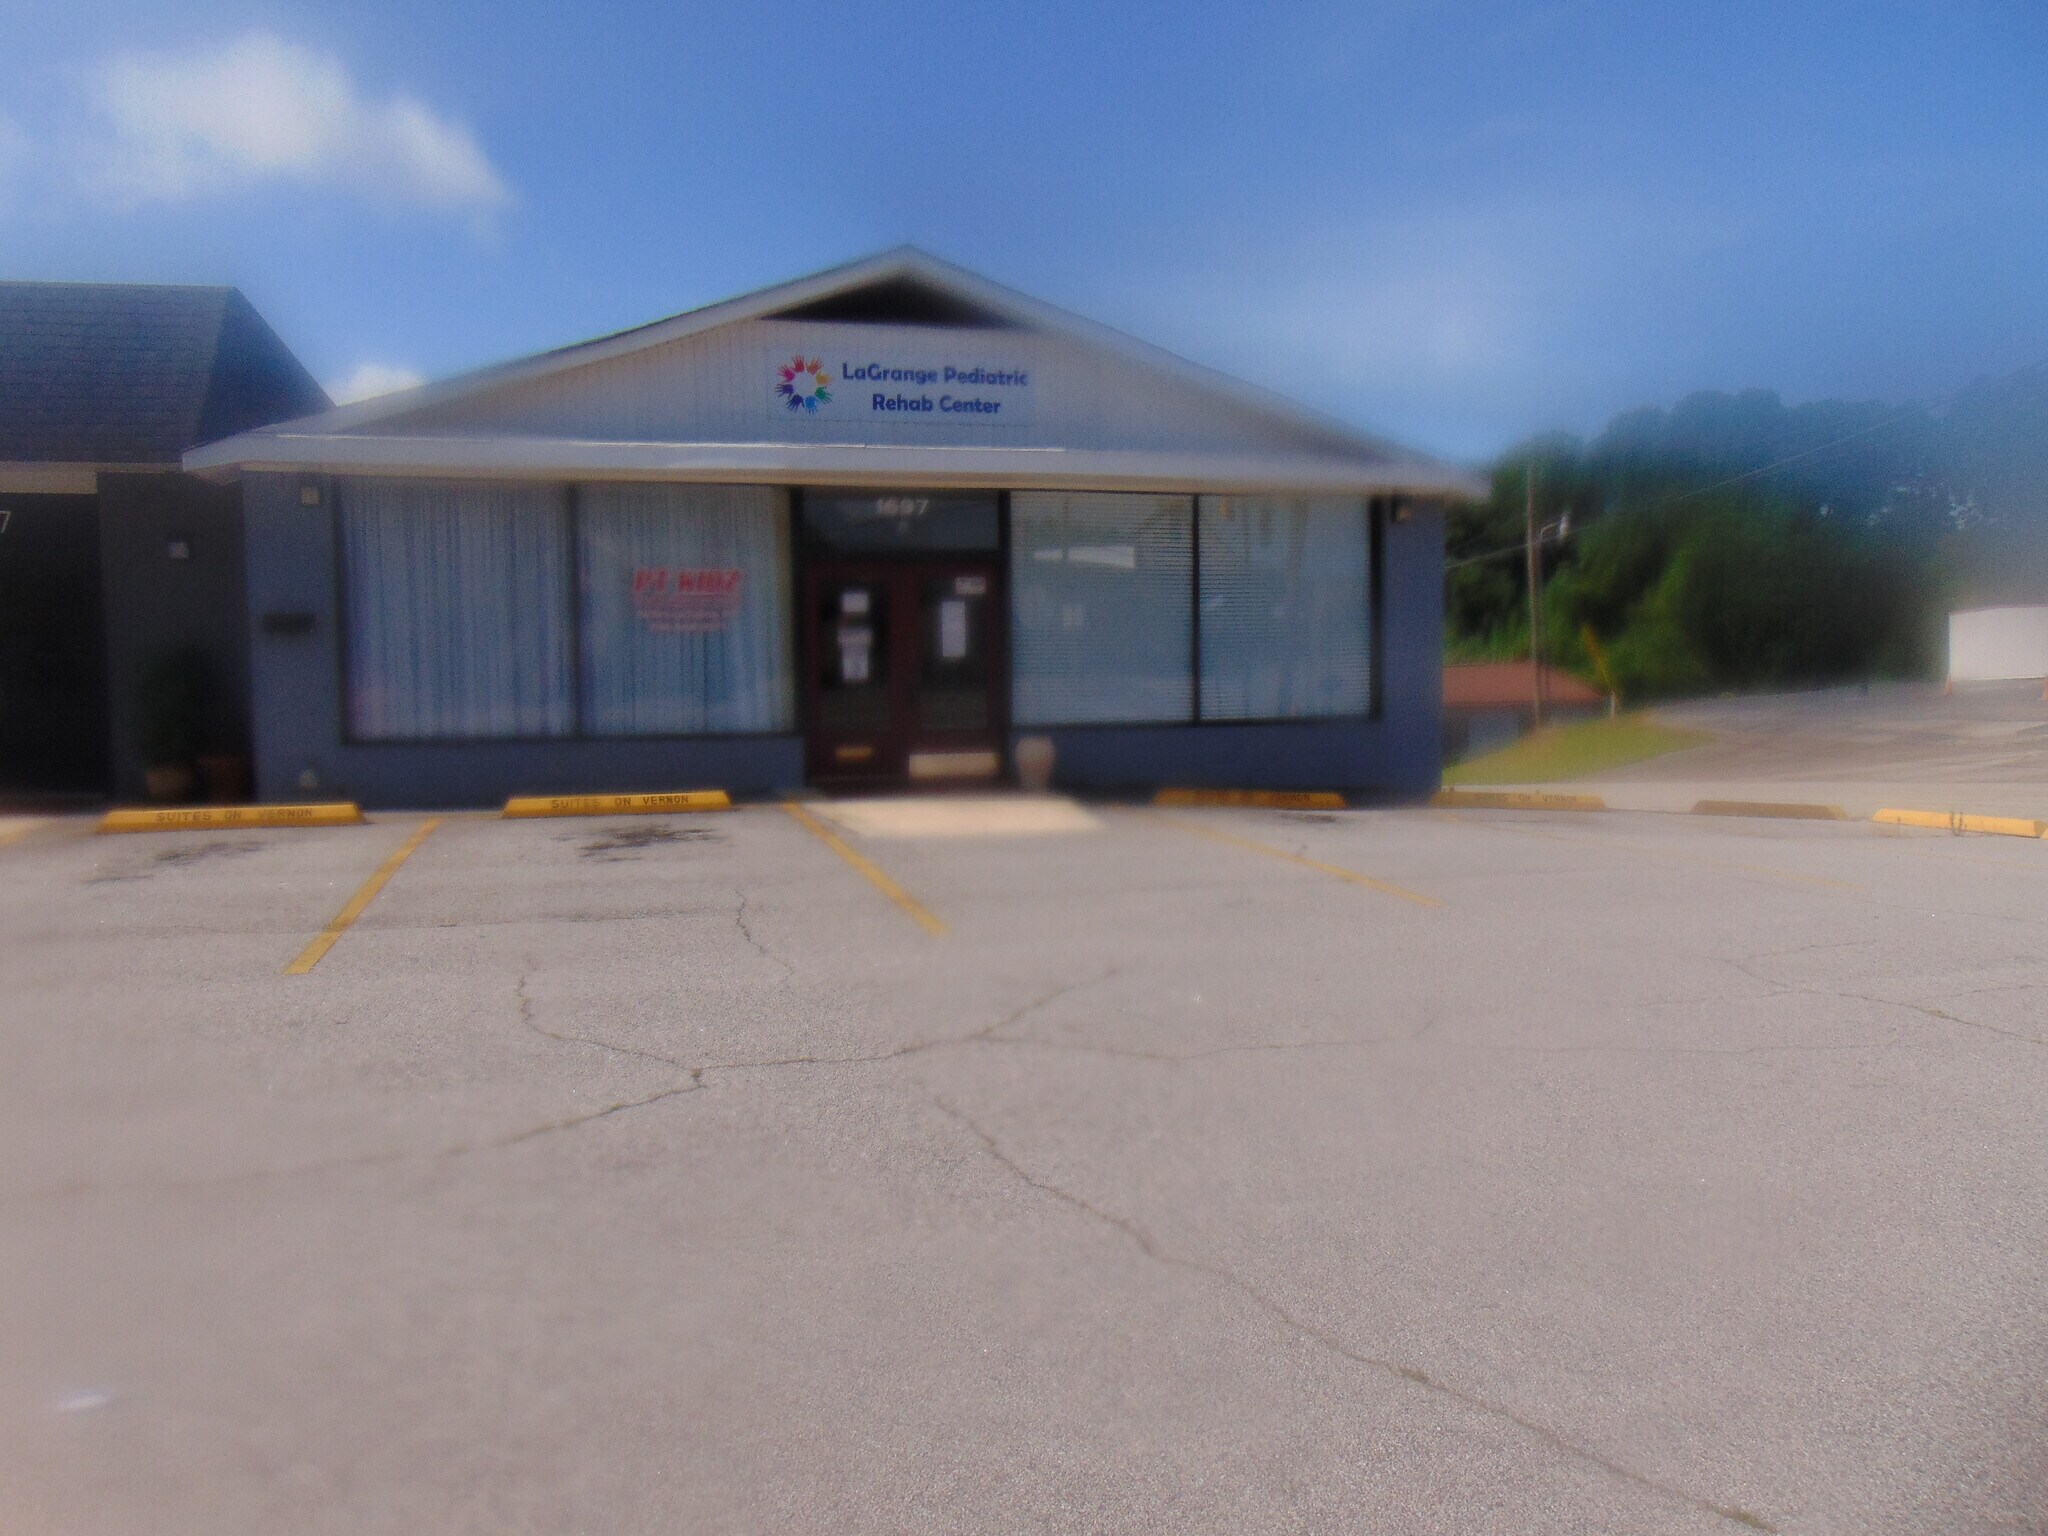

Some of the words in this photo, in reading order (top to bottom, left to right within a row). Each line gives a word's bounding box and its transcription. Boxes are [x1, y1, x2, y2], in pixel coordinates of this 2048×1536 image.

[842, 362, 937, 385] LaGrange
[944, 366, 1028, 387] Pediatric
[872, 393, 933, 413] Rehab
[940, 396, 1001, 414] Center
[551, 799, 601, 809] SUITES
[614, 797, 632, 807] ON
[642, 795, 689, 806] VERNON
[156, 811, 212, 822] SUITES
[224, 809, 242, 821] ON
[257, 807, 313, 820] VERNON
